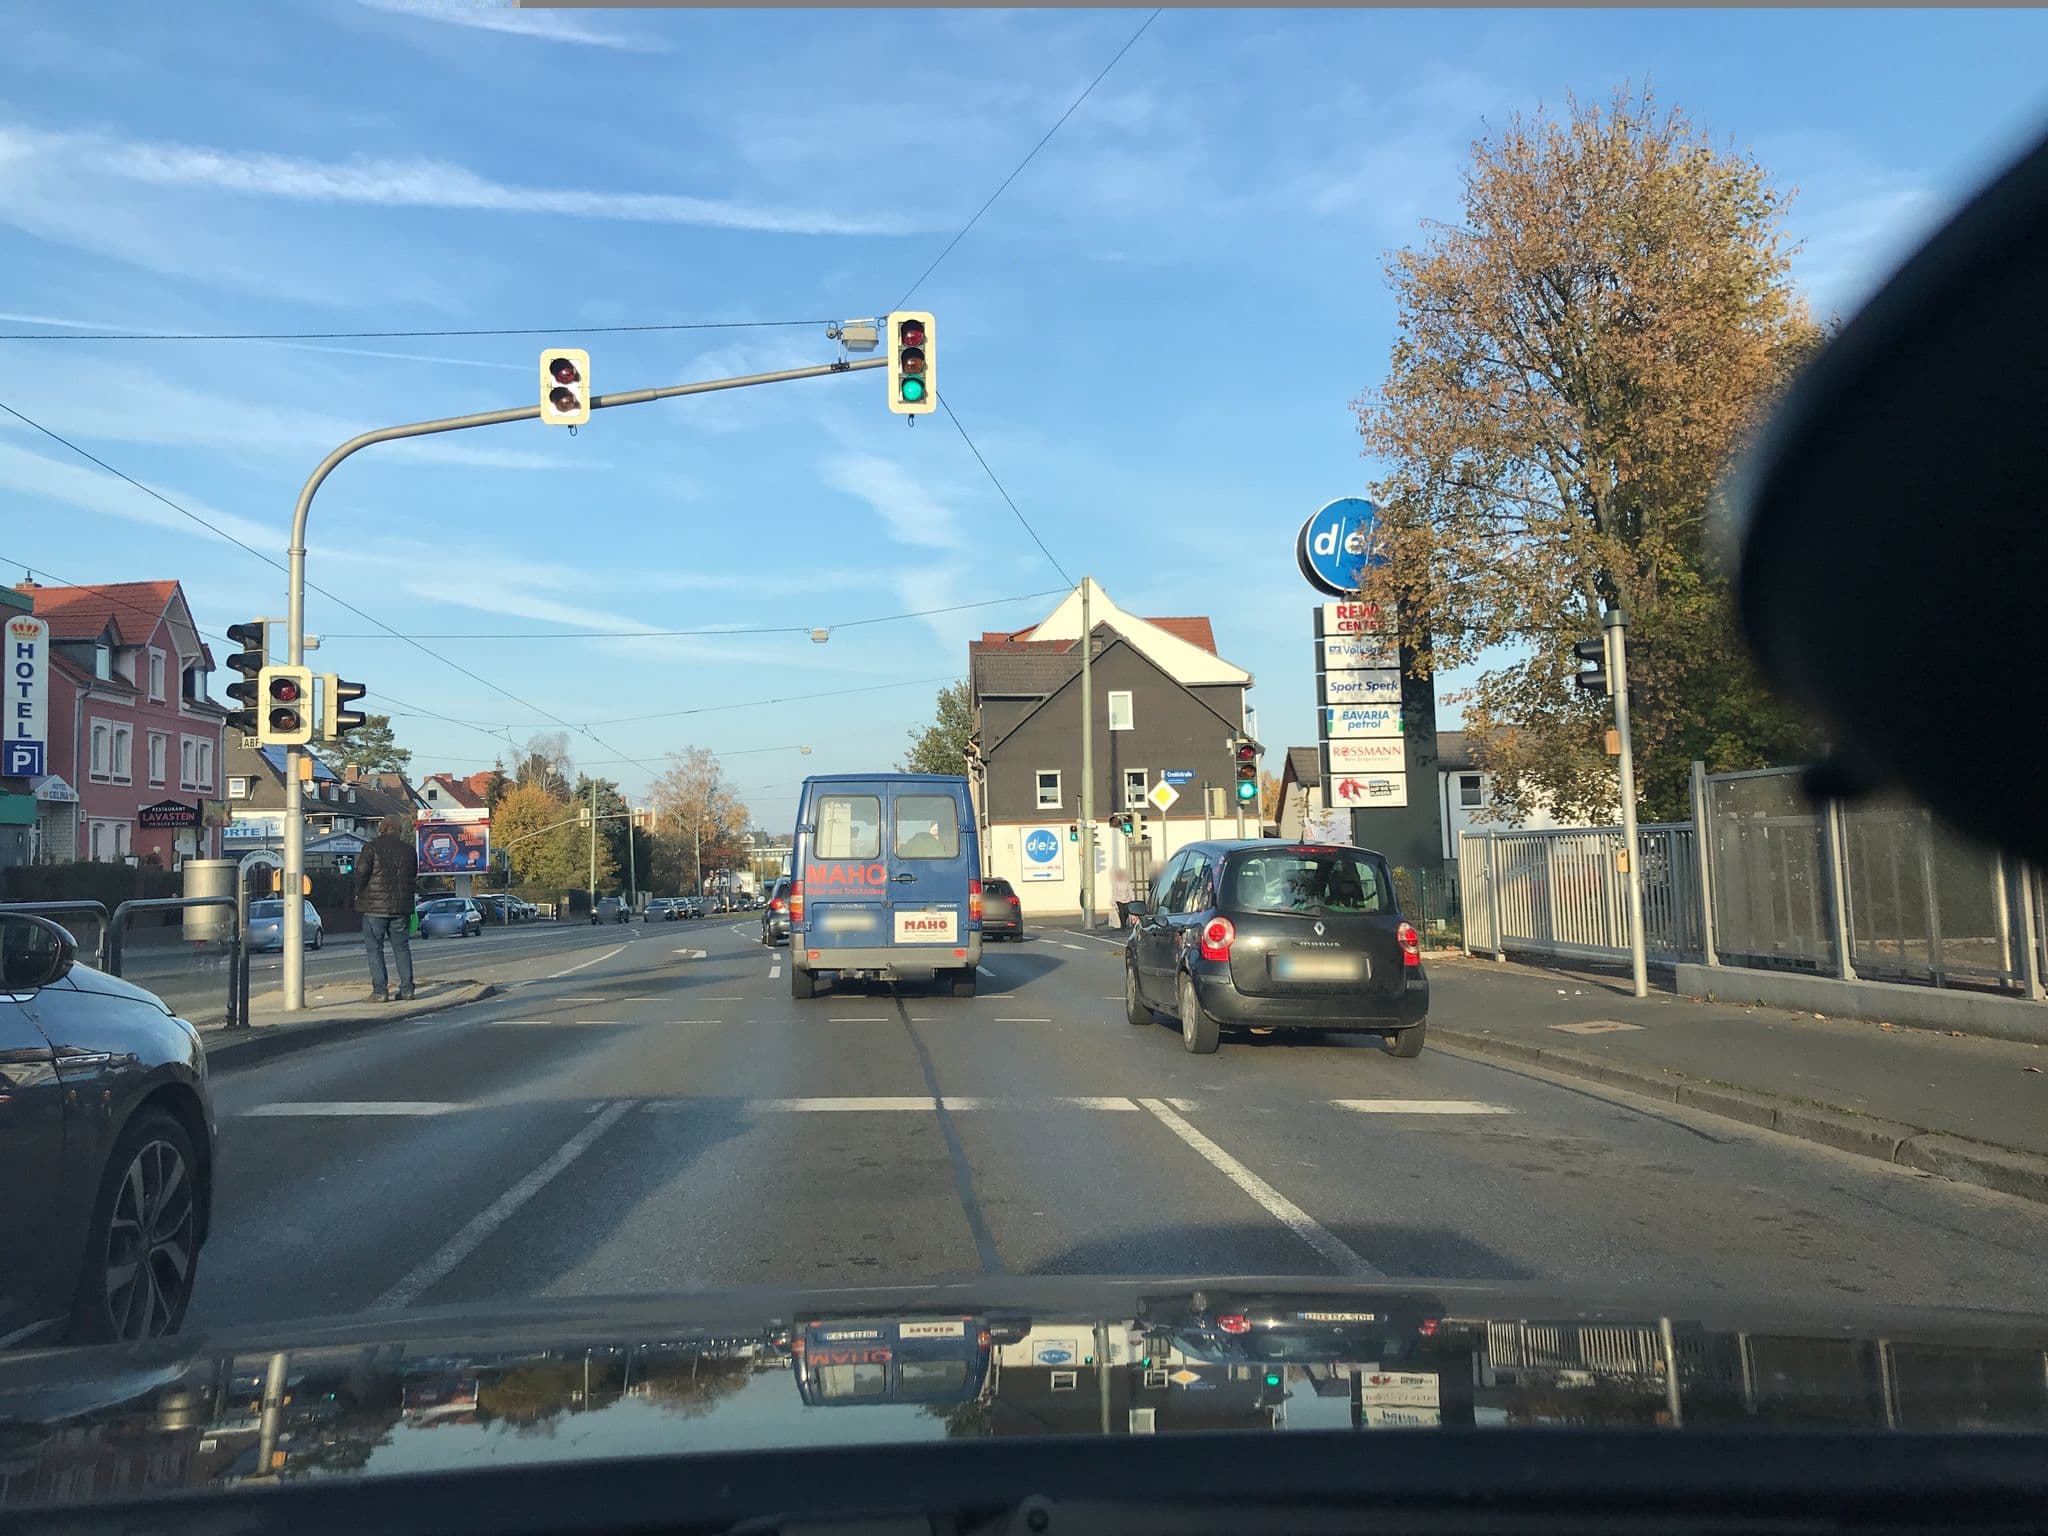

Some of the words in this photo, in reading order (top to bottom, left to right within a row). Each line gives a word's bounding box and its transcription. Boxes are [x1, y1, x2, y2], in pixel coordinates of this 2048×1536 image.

[15, 642, 34, 739] HOTEL
[1330, 682, 1362, 694] Sport
[1365, 680, 1399, 692] Sperk
[1342, 710, 1390, 721] BAVARIA
[1348, 720, 1381, 731] petrol
[1333, 745, 1401, 756] ROSSMANN
[12, 751, 32, 773] P
[143, 812, 196, 822] LAVASTEIN
[807, 863, 887, 886] MAHO
[904, 920, 948, 930] MAHO
